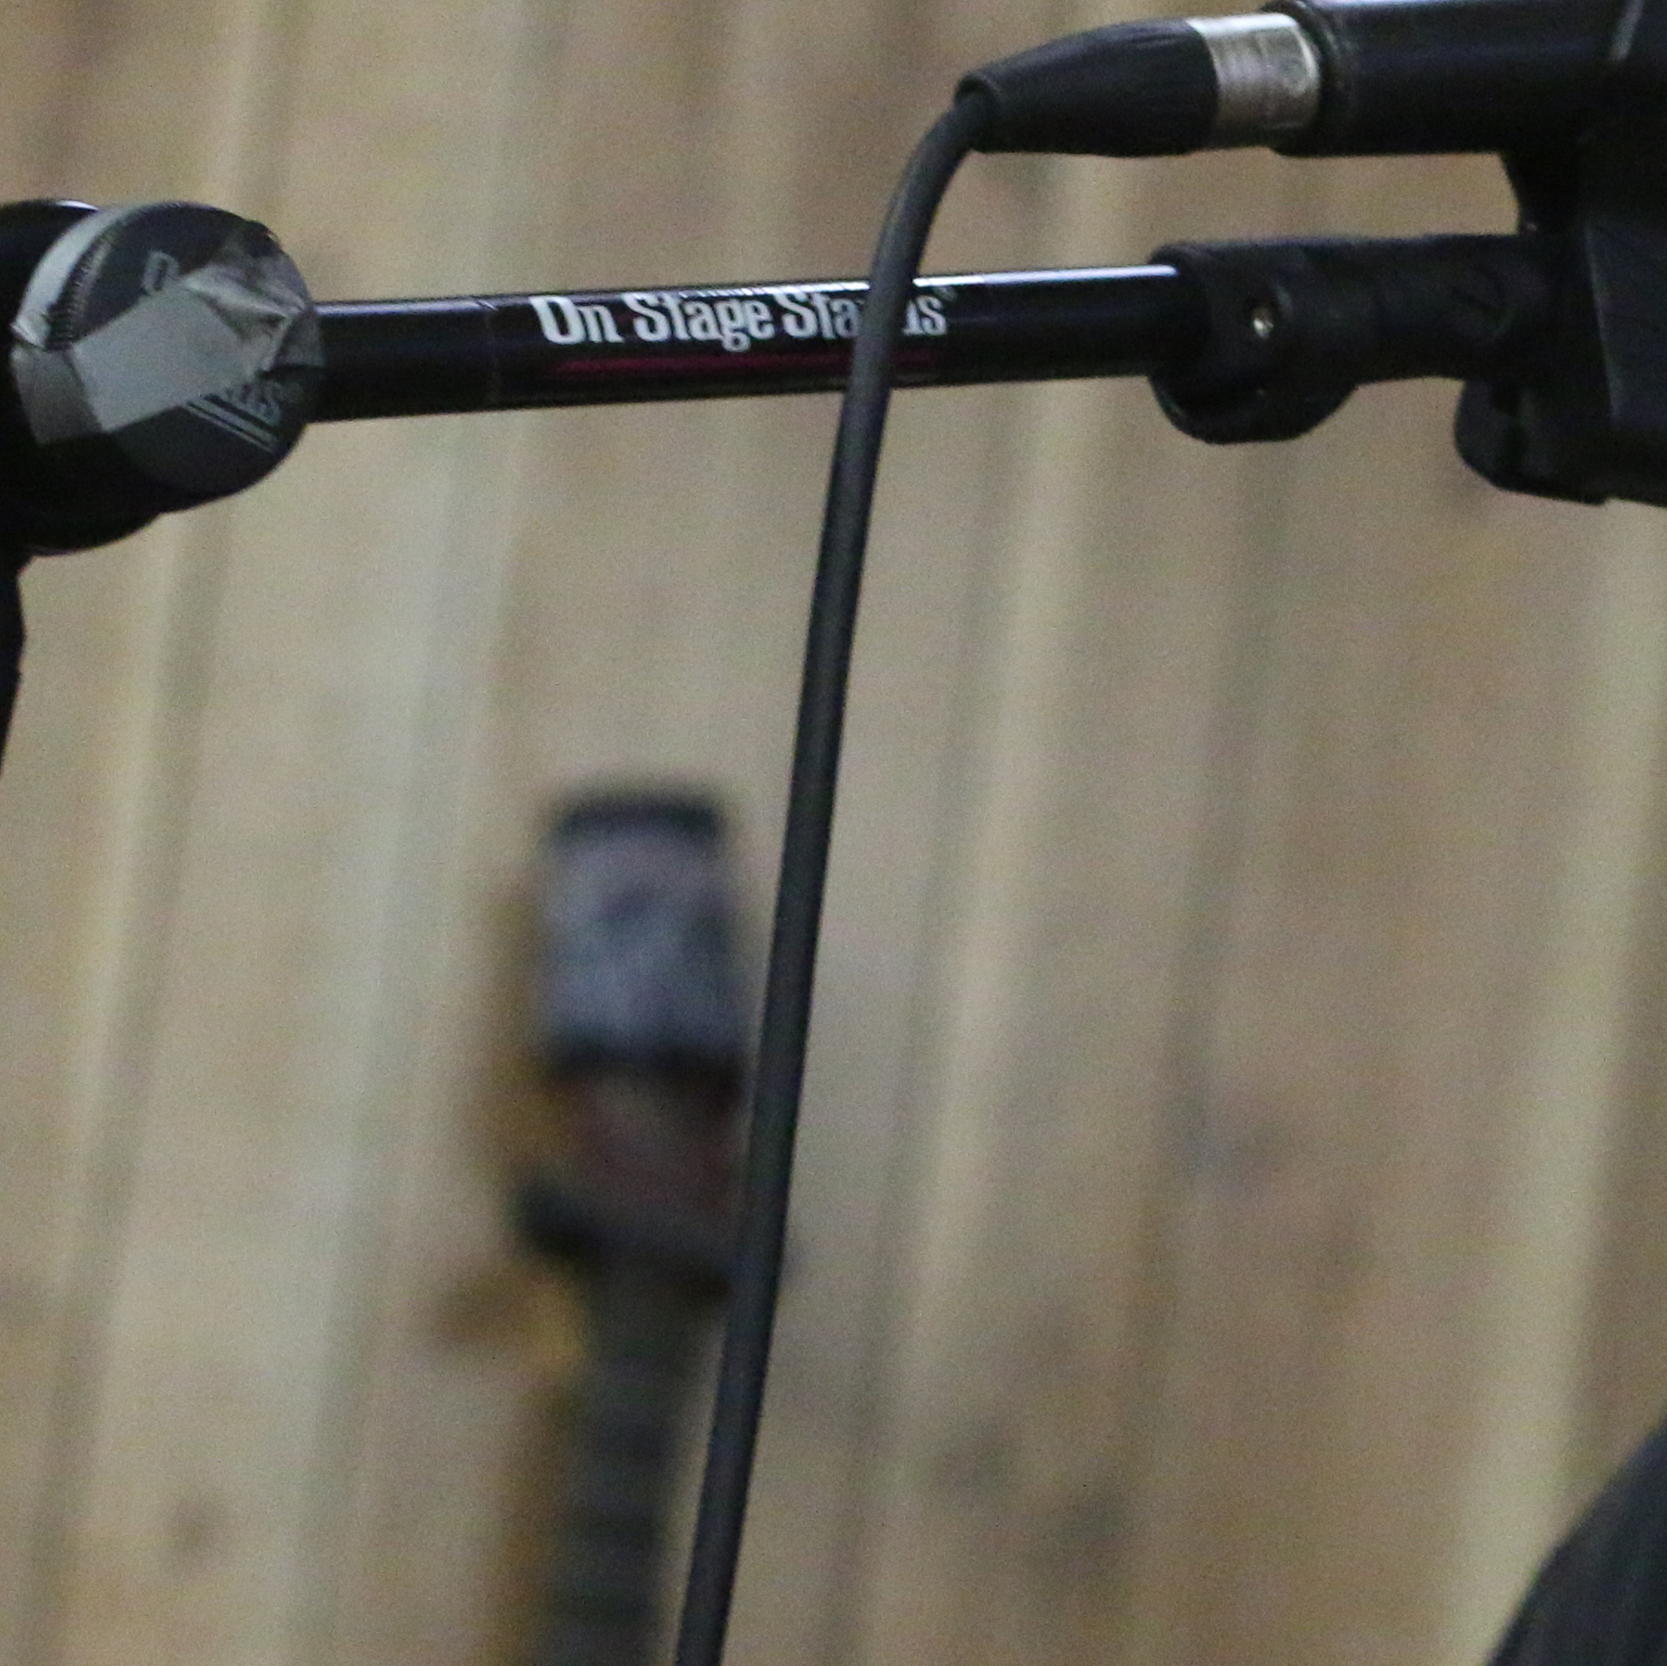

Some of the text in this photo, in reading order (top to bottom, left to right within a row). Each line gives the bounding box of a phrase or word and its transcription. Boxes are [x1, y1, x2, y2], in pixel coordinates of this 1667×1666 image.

[530, 289, 948, 353] On Stage Stas
